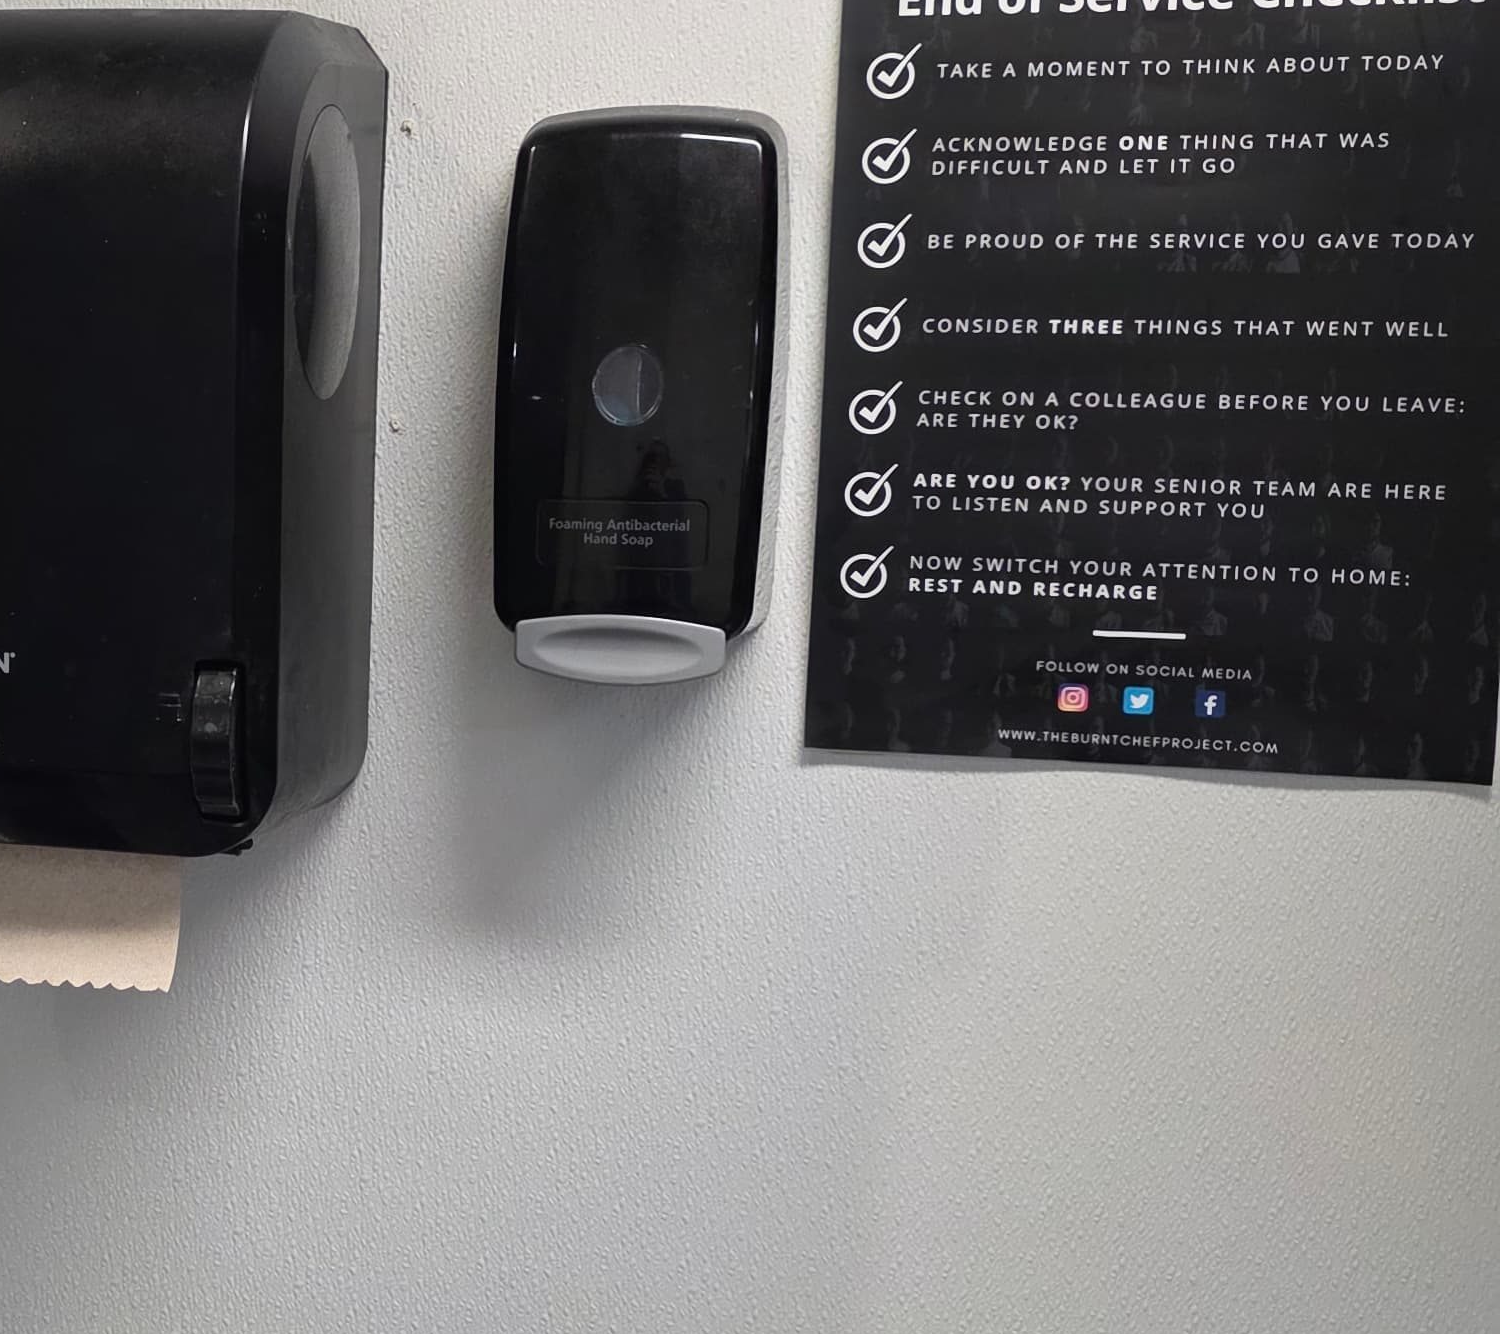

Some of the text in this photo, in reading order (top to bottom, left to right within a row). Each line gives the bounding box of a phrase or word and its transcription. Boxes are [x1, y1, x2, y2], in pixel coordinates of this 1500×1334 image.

[937, 54, 1444, 79] TAKE A MOMENT TO THINK ABOUT TODAY
[931, 132, 1389, 153] ACKNOWLEDGE ONE THING THAT WAS
[931, 157, 1235, 176] DIFFICULT AND LET IT GO
[927, 233, 1474, 249] BE PROUD OF THE SERVICE YOU GAVE TODAY
[922, 318, 1448, 337] CONSIDER THREE THINGS THAT WENT WELL
[918, 390, 1465, 413] CHECK ON A COLLEAGUE BEFORE YOU LEAVE:
[916, 412, 1079, 430] ARE THEY OK?
[913, 473, 1446, 501] ARE YOU OK? YOUR SENIOR TEAM ARE HERE
[912, 495, 1264, 519] TO LISTEN AND SUPPORT YOU
[549, 518, 690, 532] Foaming Antibacterial
[584, 533, 653, 547] Hand Soap
[909, 555, 1410, 587] NOW SWITCH YOUR ATTENTION TO HOME:
[908, 577, 1157, 601] REST AND RECHARGE
[1035, 660, 1252, 680] FOLLOW ON SOCIAL MEDIA
[998, 729, 1278, 754] WWW.THEBURNTCHEFPROJECT.COM
